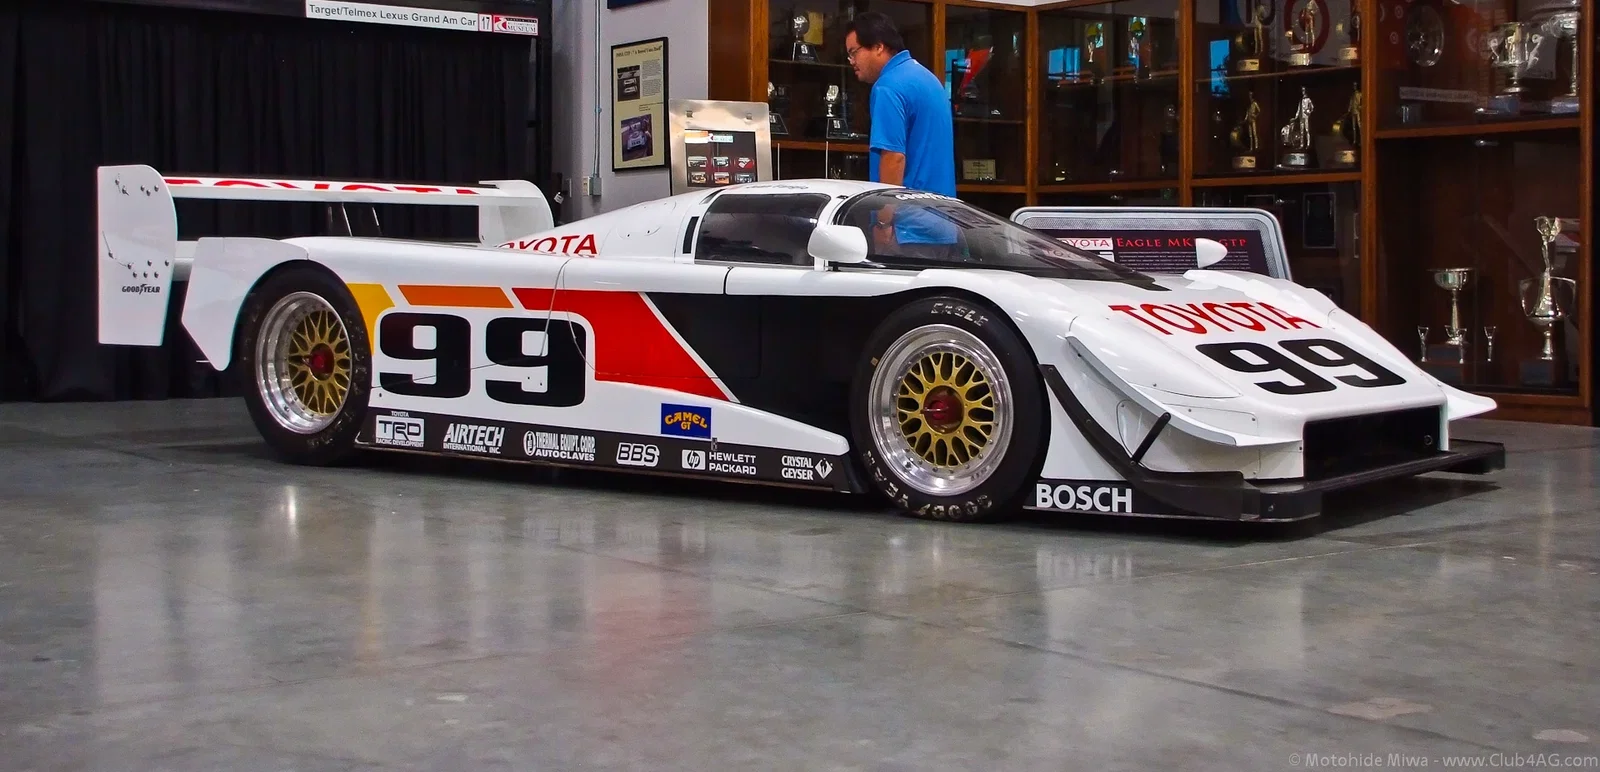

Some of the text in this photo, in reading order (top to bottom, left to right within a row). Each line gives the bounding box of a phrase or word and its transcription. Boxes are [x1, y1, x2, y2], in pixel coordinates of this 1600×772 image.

[309, 4, 476, 26] Target/Telmex Lexus Grand Am Car
[481, 16, 490, 30] 17
[1116, 237, 1161, 247] EAGLE
[121, 283, 161, 295] GOODYEAR
[1109, 301, 1323, 335] TOYOTA
[379, 312, 587, 408] 99
[1195, 338, 1407, 395] 99
[391, 410, 409, 418] TOYOTA
[665, 411, 708, 429] CAMEL
[379, 420, 421, 440] TRD
[680, 421, 691, 431] GT
[443, 422, 505, 447] AIRTECH
[536, 431, 559, 450] THERMAL
[392, 440, 424, 448] DEVELOPMENT
[443, 442, 502, 454] INTERNATIONAL INC.
[535, 448, 595, 461] AUTOCLAVES
[617, 443, 659, 466] BBS
[709, 451, 757, 464] HEWLETT
[709, 462, 757, 475] PACKARD
[781, 455, 814, 469] CRYSTAL
[781, 467, 814, 481] GEYSER
[1036, 483, 1132, 513] BOSCH
